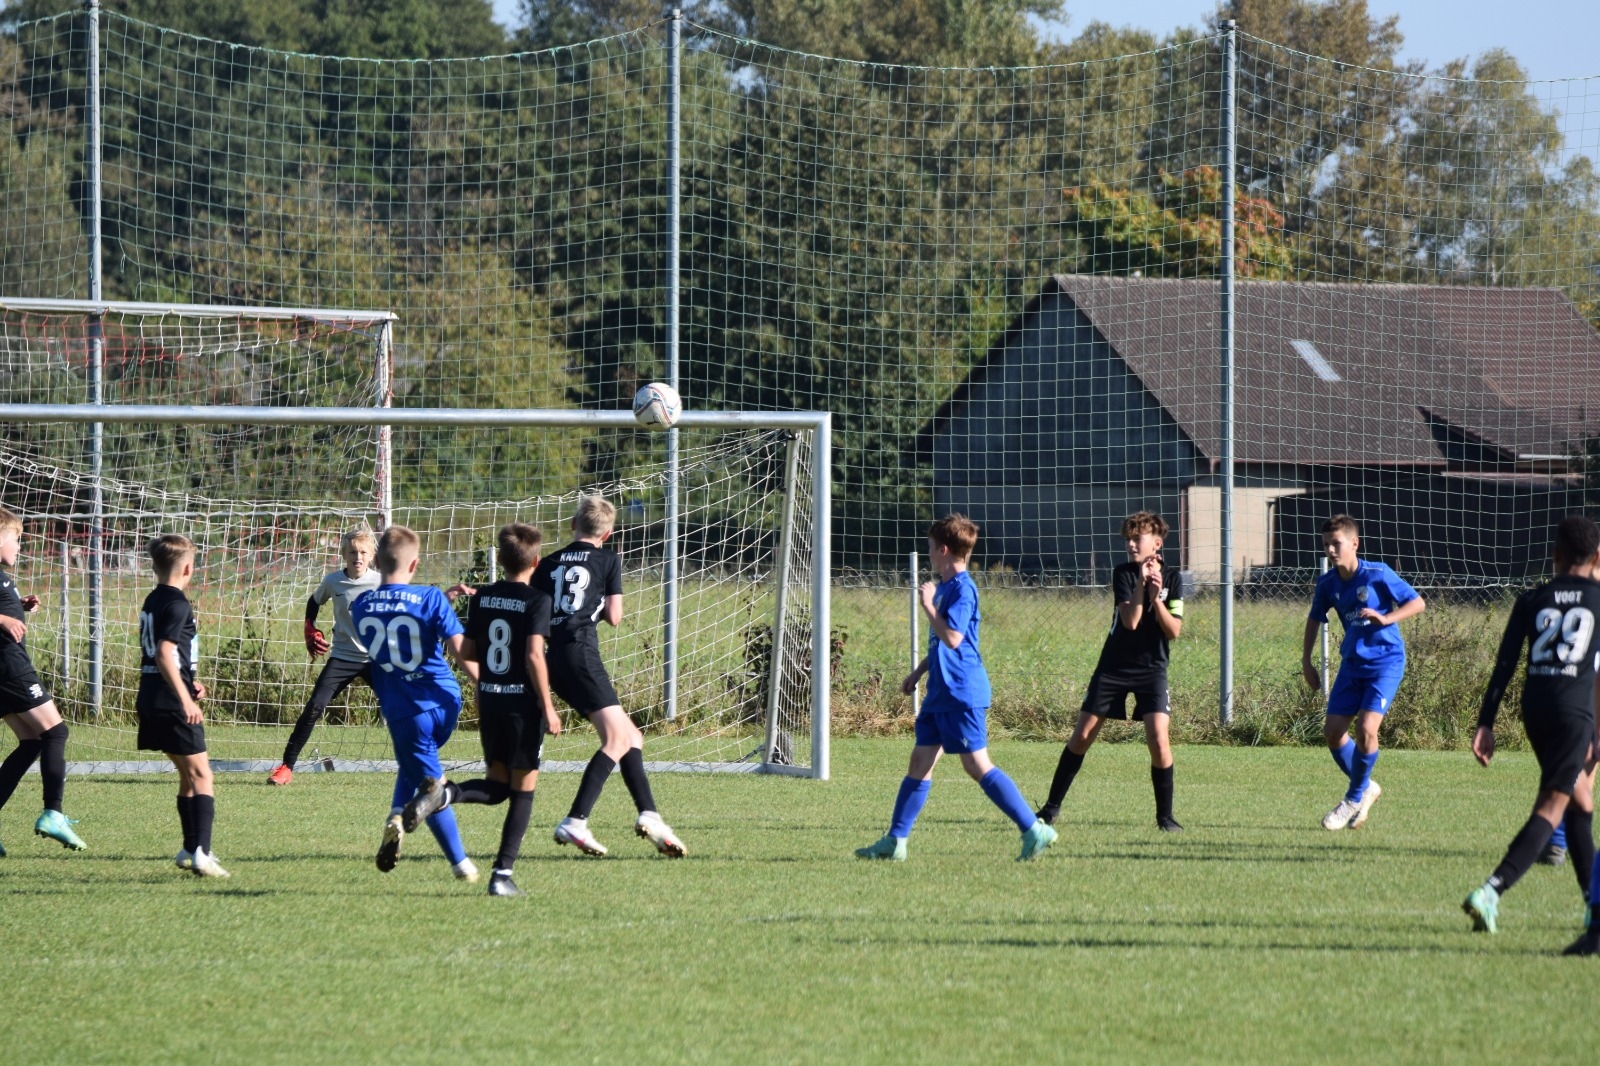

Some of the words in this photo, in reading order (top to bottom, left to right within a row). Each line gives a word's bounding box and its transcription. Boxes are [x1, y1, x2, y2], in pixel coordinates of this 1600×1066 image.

[560, 551, 591, 562] KNAUT
[367, 590, 392, 601] CARL
[549, 564, 591, 614] 13
[1555, 590, 1582, 604] VOGT
[365, 602, 408, 613] JENA
[480, 596, 526, 613] HILGENBERG
[358, 615, 423, 673] 20
[1531, 607, 1596, 664] 29
[486, 618, 512, 675] 8
